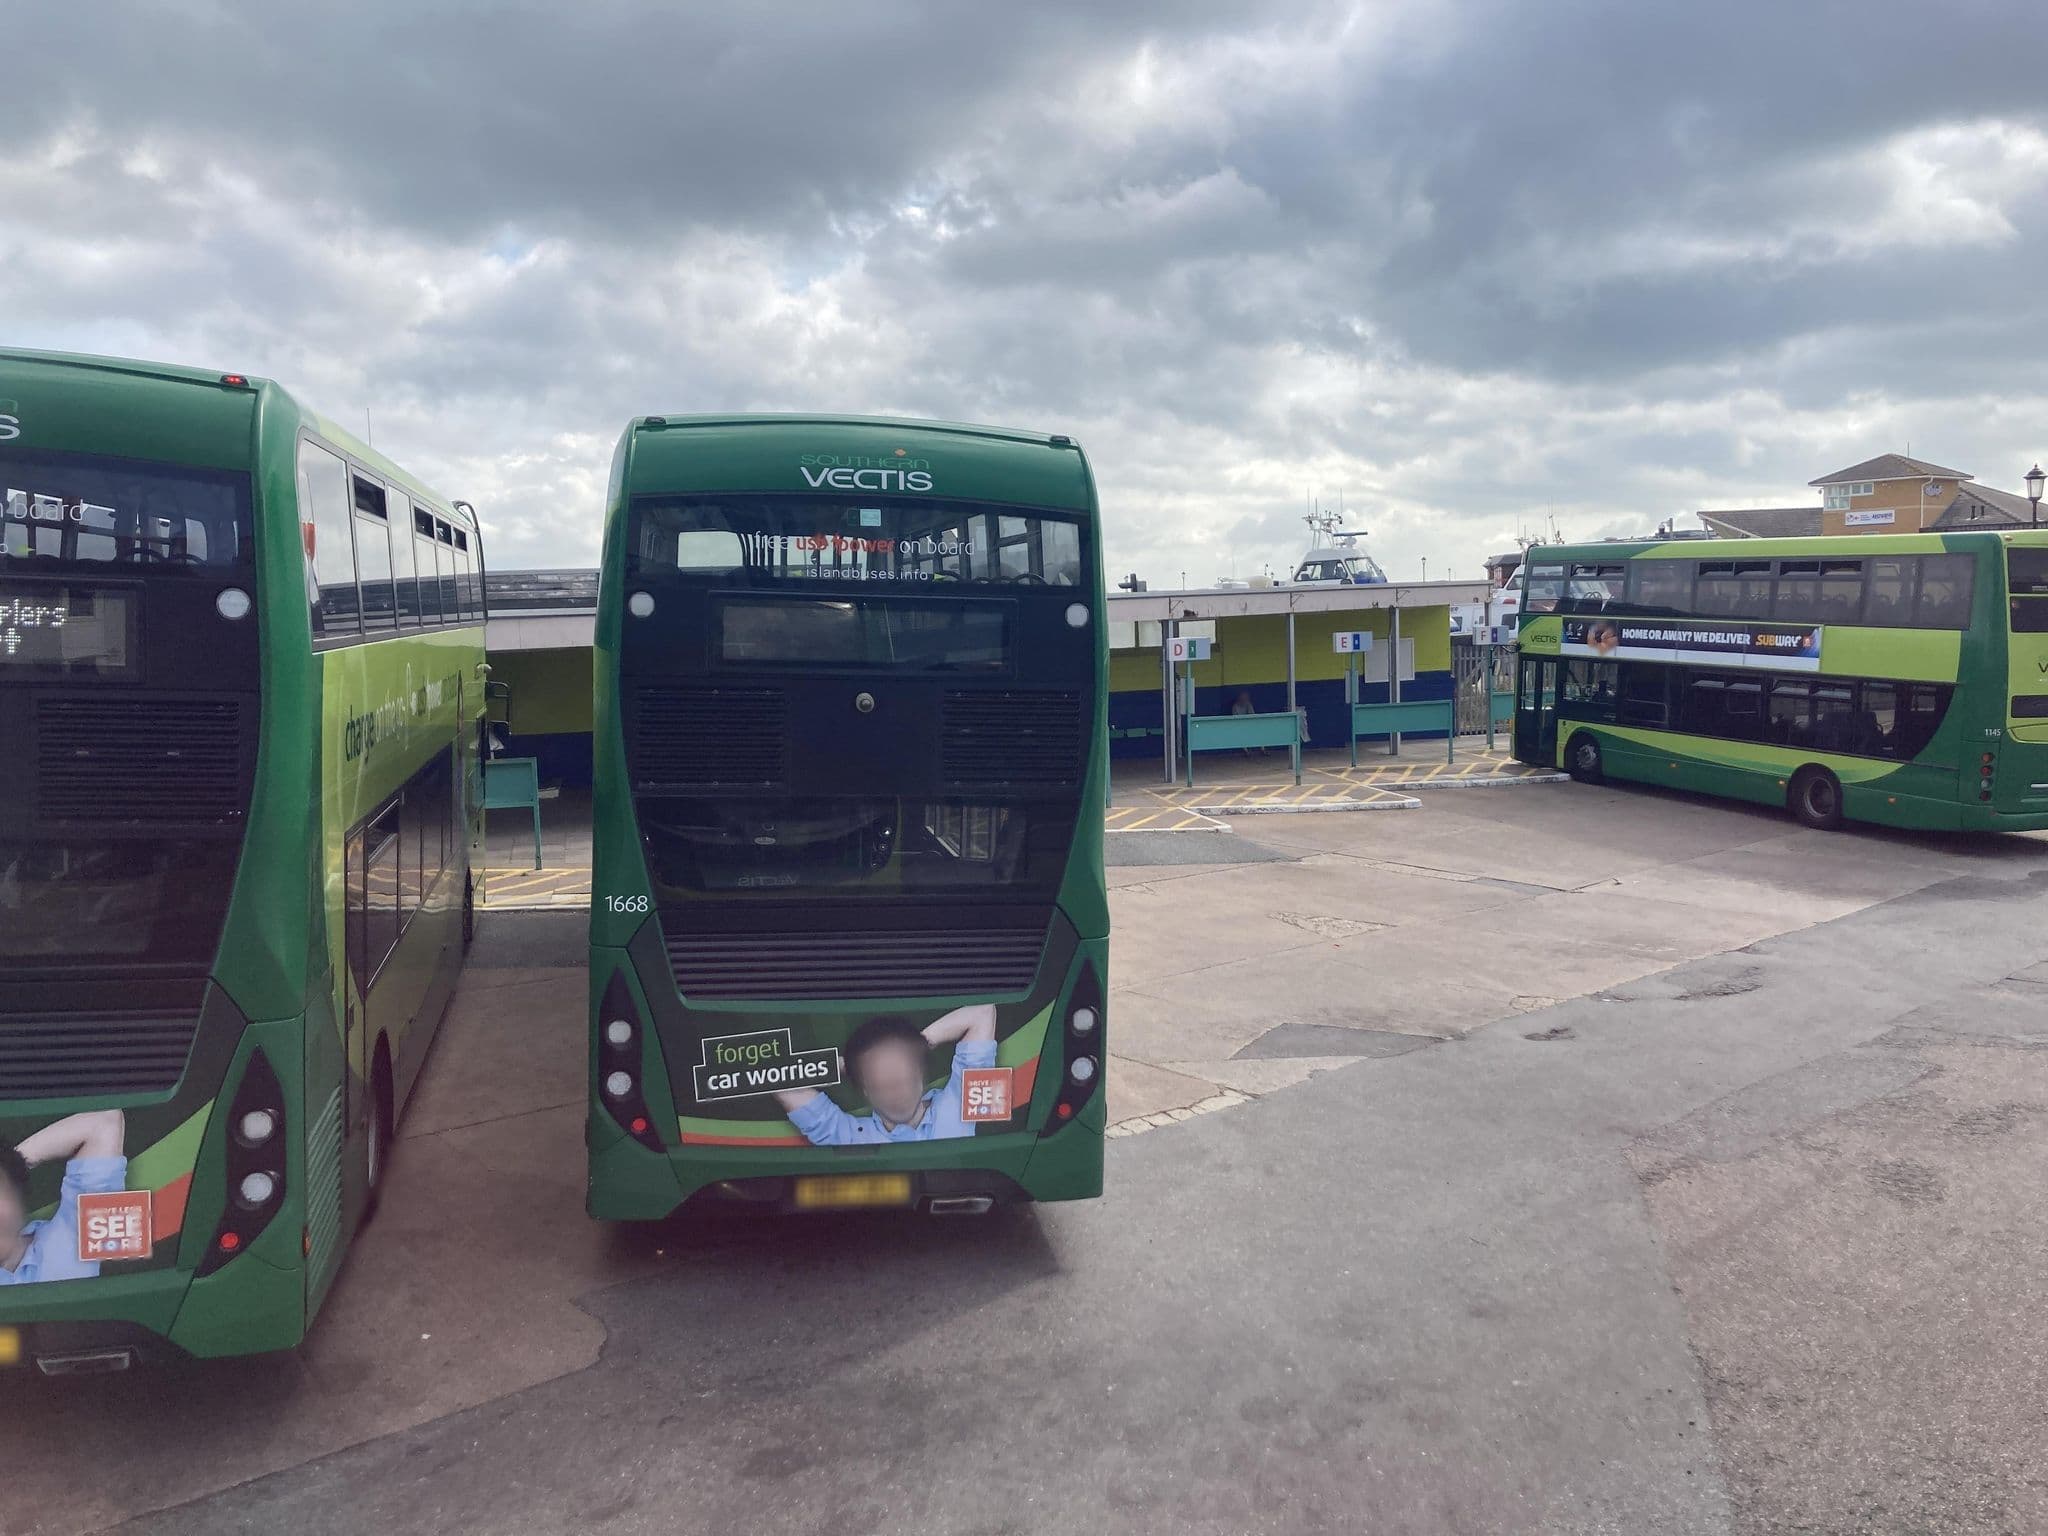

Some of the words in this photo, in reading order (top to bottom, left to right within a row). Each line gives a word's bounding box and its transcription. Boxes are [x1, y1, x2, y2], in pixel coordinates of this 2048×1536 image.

[800, 466, 934, 492] VECTIS
[14, 495, 83, 522] board
[753, 531, 788, 550] free
[835, 537, 895, 557] power
[900, 540, 921, 554] on
[928, 538, 975, 556] board
[806, 567, 928, 582] islandbuses.info
[1341, 637, 1347, 648] E
[1480, 630, 1487, 641] F
[1531, 635, 1557, 644] VECTIS
[1622, 628, 1648, 640] HOME
[1649, 630, 1661, 641] OR
[1662, 631, 1692, 643] AWAY?
[1693, 632, 1707, 643] WE
[1708, 633, 1750, 645] DELIVER
[1756, 634, 1801, 648] SUBWAY
[1174, 643, 1183, 656] D
[1984, 728, 2001, 737] 1145
[604, 895, 648, 913] 1668
[715, 1039, 781, 1064] forget
[706, 1069, 740, 1091] car
[745, 1057, 829, 1087] worries
